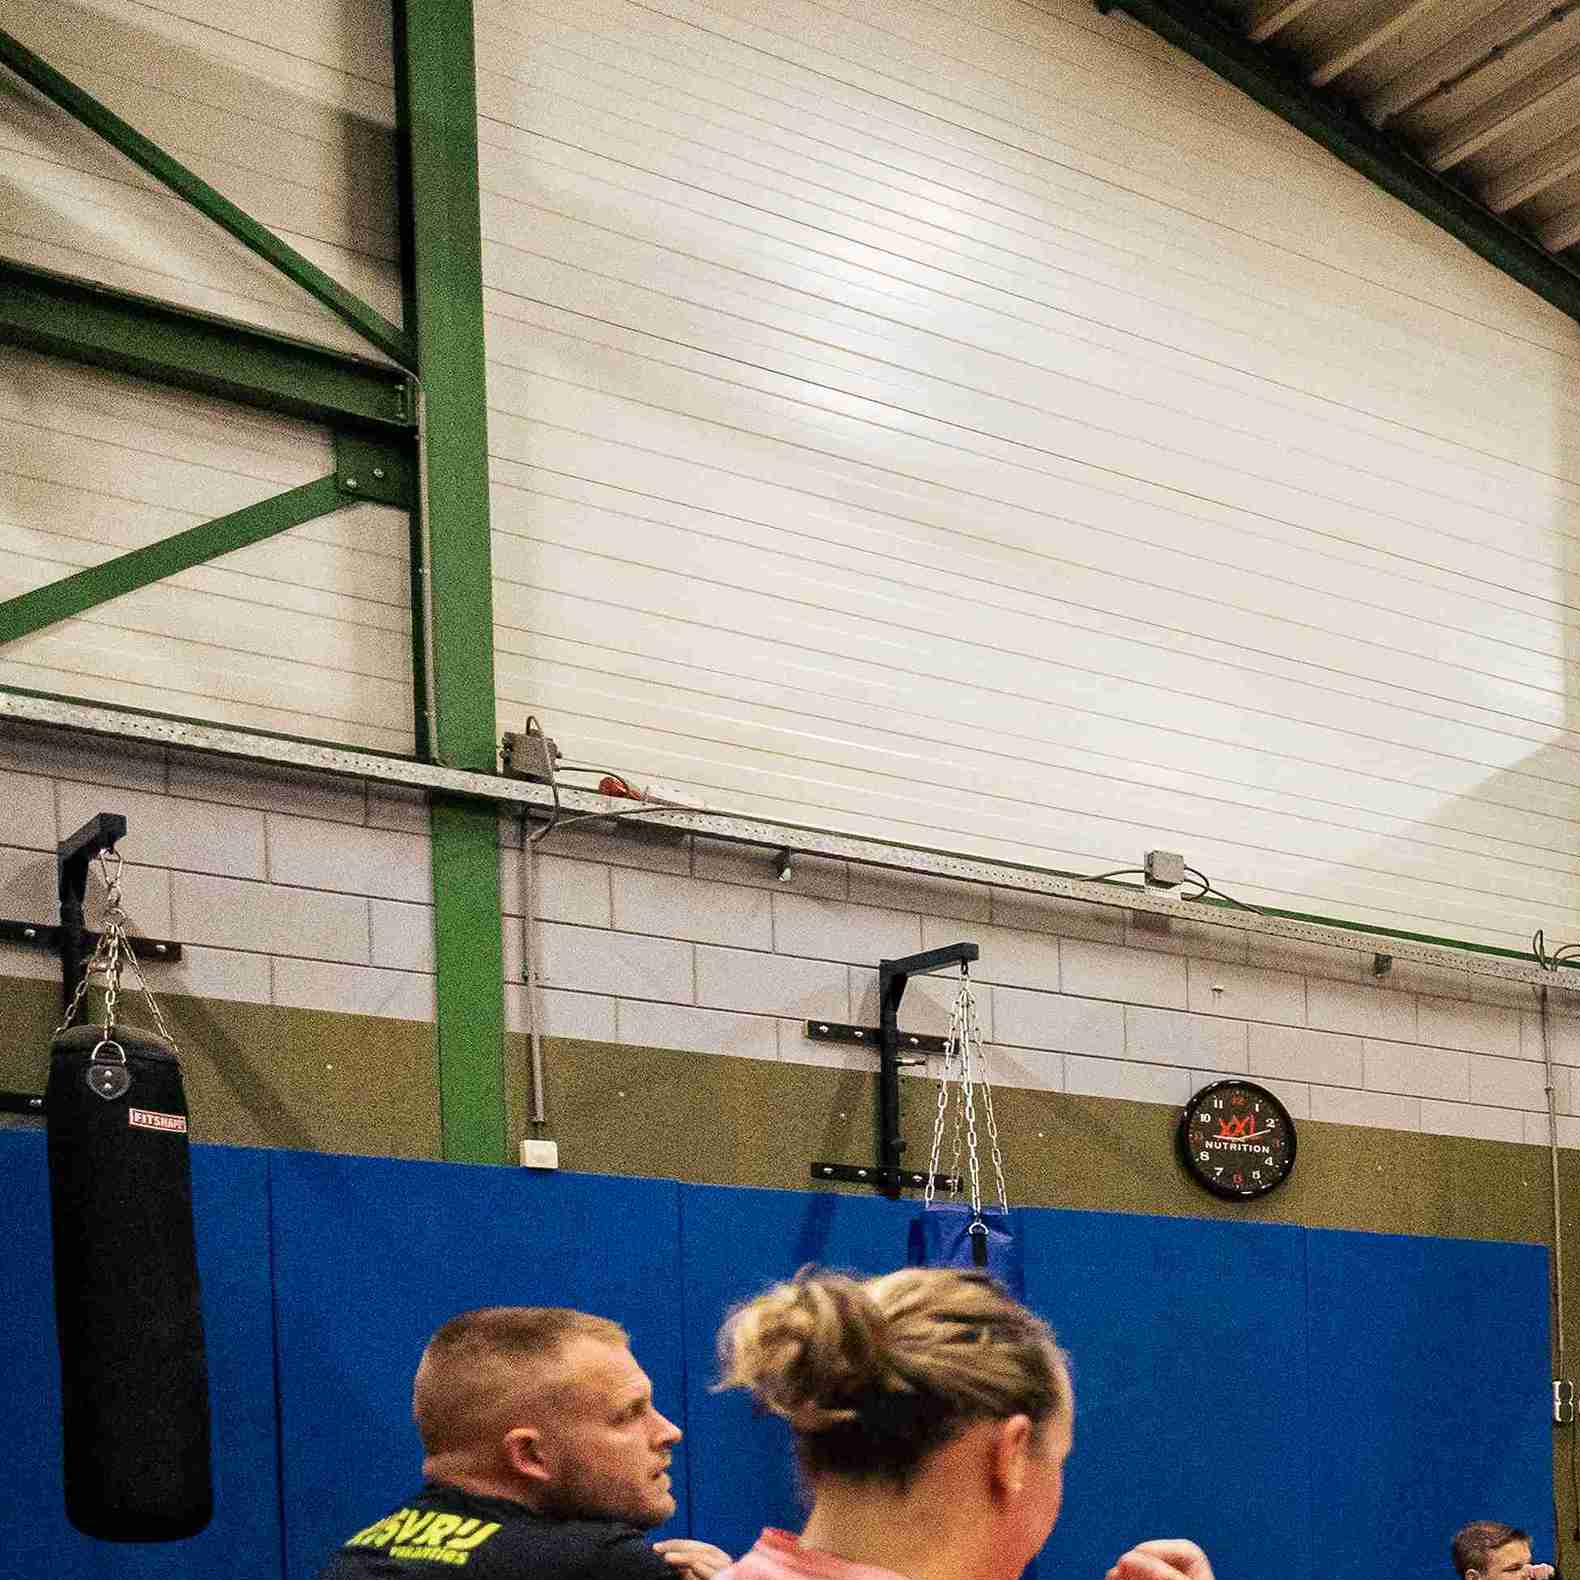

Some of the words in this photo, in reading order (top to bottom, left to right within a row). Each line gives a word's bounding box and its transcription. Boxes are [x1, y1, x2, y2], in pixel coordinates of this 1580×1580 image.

[1213, 1097, 1224, 1109] 11
[1254, 1103, 1260, 1112] 1
[1200, 1113, 1211, 1122] 10
[1265, 1118, 1276, 1128] 2
[1205, 1141, 1270, 1154] NUTRITION
[1200, 1151, 1210, 1161] 8
[1264, 1156, 1274, 1166] 4
[1214, 1167, 1224, 1176] 7
